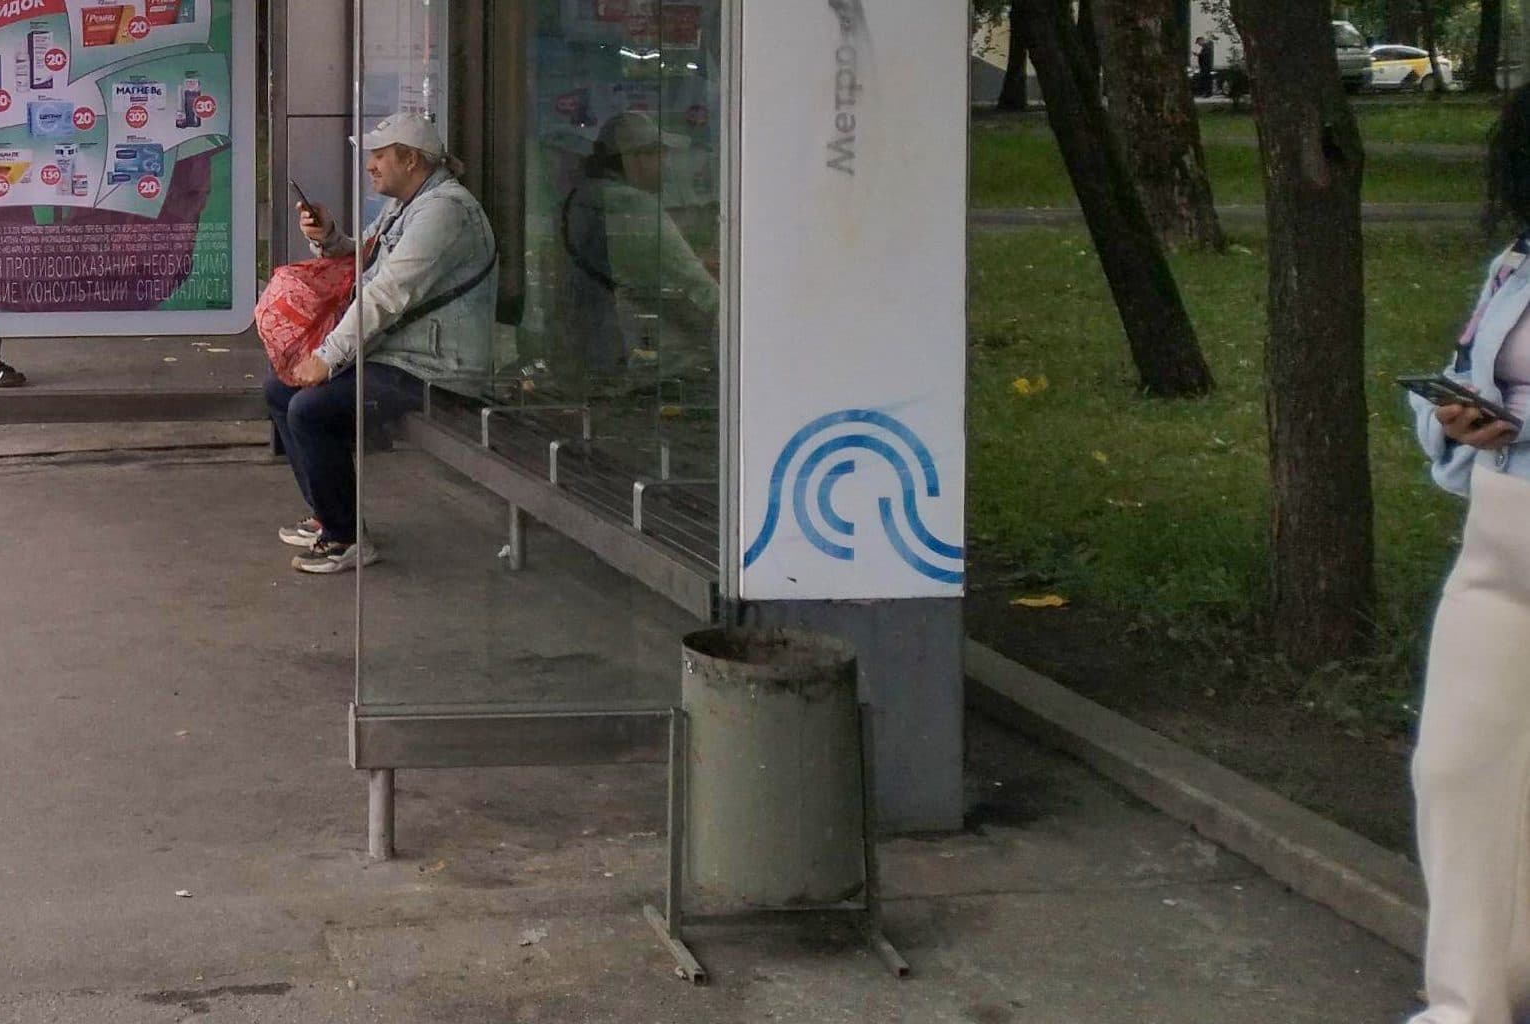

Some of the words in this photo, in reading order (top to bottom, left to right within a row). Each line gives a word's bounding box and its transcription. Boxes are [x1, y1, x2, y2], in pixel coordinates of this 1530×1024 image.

[826, 45, 863, 176] Метро
[144, 253, 228, 275] НЕОБХОДИМО
[27, 280, 128, 303] КОНСУЛЬТАЦИИ
[137, 278, 228, 301] СПЕЦИАЛИСТА
